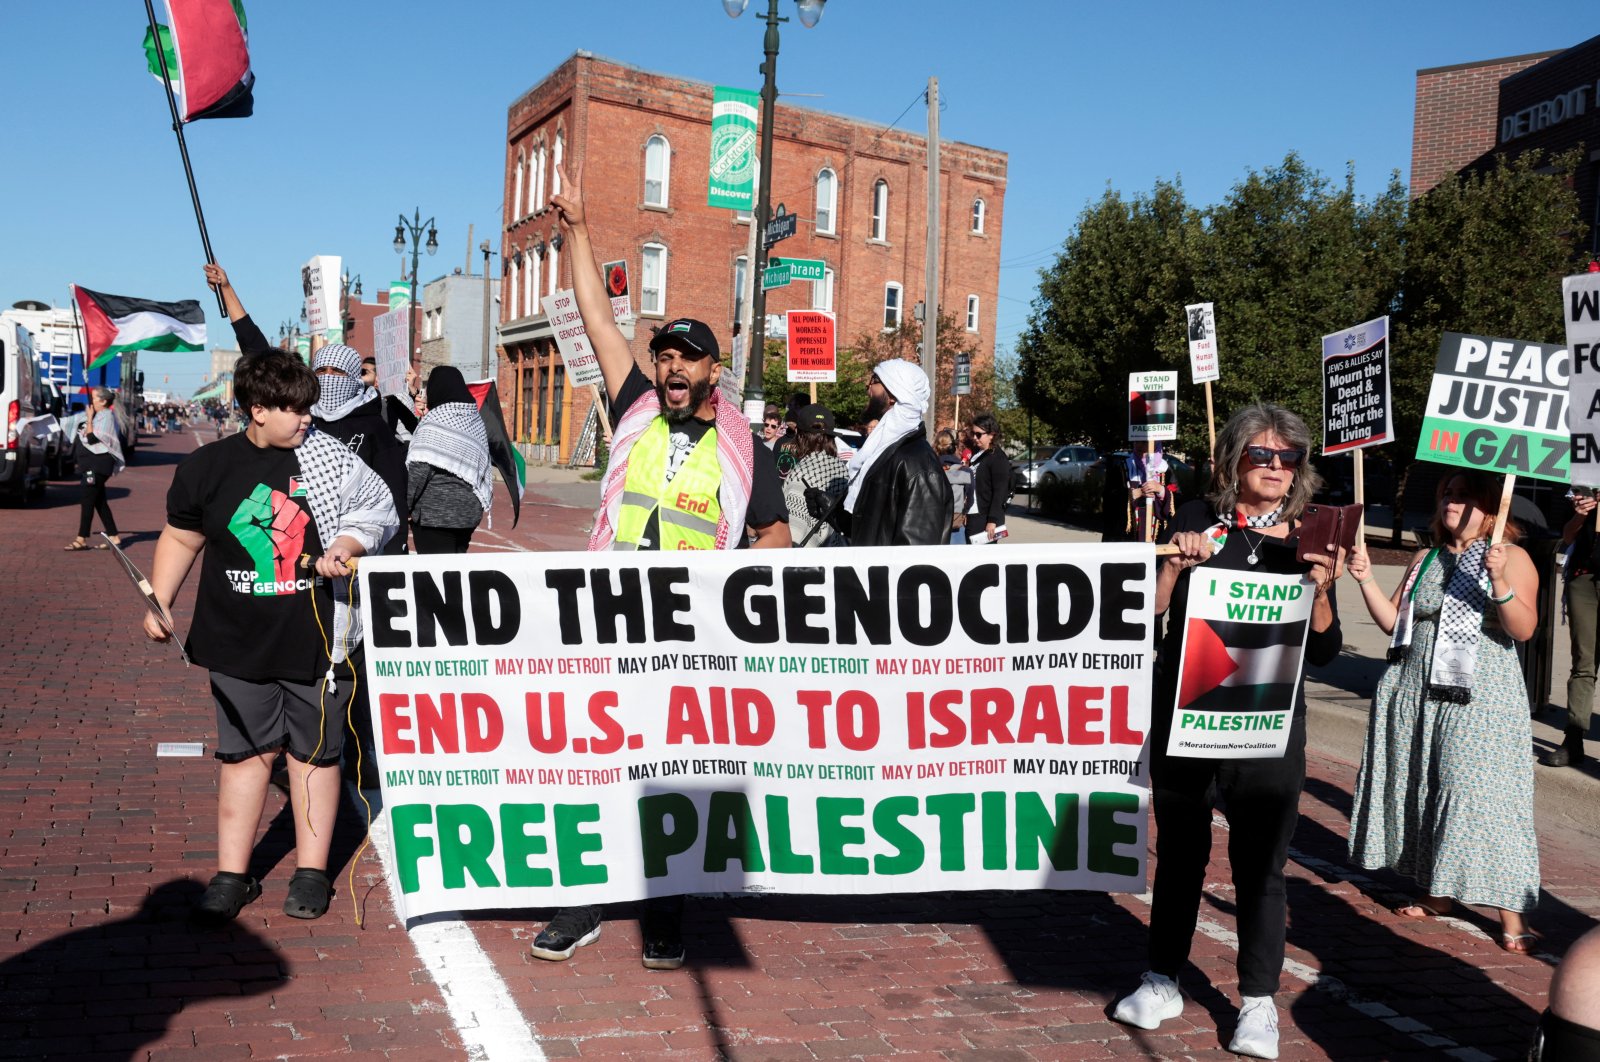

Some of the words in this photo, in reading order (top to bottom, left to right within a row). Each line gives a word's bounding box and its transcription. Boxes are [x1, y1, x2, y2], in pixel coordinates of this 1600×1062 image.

[1501, 85, 1592, 143] DETROIT
[712, 132, 756, 176] Corktown
[710, 186, 752, 199] Discover
[767, 218, 790, 236] Michigan
[773, 260, 821, 277] hrane
[765, 270, 790, 285] Michigan
[554, 297, 570, 310] STOP
[550, 311, 581, 327] U.S./ISRA
[613, 307, 630, 317] OW!
[792, 315, 801, 323] ALL
[803, 315, 822, 323] POWER
[558, 325, 586, 340] GENOCID
[795, 326, 822, 334] WORKERS
[574, 341, 584, 352] IN
[795, 337, 827, 345] OPPRESSED
[1197, 342, 1211, 350] Fund
[799, 347, 824, 355] PEOPLES
[1195, 353, 1213, 361] Human
[568, 355, 597, 369] PALESTIN
[811, 358, 833, 366] WORLD!
[1196, 364, 1215, 373] Needs!
[1327, 361, 1344, 374] JEWS
[1344, 359, 1350, 369] &
[1350, 353, 1371, 367] ALLIES
[1371, 349, 1384, 361] SAY
[1454, 337, 1570, 387] PEAC
[1143, 375, 1170, 383] STAND
[1329, 370, 1363, 389] Mourn
[1363, 363, 1382, 377] the
[1143, 383, 1164, 391] WITH
[1338, 381, 1363, 401] Dead
[1365, 378, 1374, 392] &
[1331, 399, 1358, 417] Fight
[1359, 394, 1380, 409] Like
[1438, 379, 1570, 431] JUSTI
[1328, 415, 1349, 432] Hell
[1350, 411, 1366, 423] for
[1366, 406, 1384, 421] the
[1132, 424, 1174, 432] PALESTINE
[1340, 425, 1372, 443] Living
[1429, 429, 1460, 453] IN
[1462, 428, 1570, 479] GAZ
[675, 492, 710, 514] End
[225, 569, 259, 582] STOP
[229, 580, 251, 594] THE
[1209, 579, 1217, 596] I
[1228, 581, 1303, 601] STAND
[368, 570, 521, 648] END
[545, 566, 696, 645] THE
[723, 562, 1147, 647] GENOCIDE
[1226, 602, 1283, 622] WITH
[376, 660, 401, 677] MAY
[406, 660, 430, 677] DAY
[435, 659, 489, 677] DETROIT
[495, 658, 523, 675] MAY
[528, 658, 553, 675] DAY
[558, 657, 612, 674] DETROIT
[618, 657, 647, 674] MAY
[652, 653, 678, 672] DAY
[683, 654, 738, 672] DETROIT
[745, 656, 775, 672] MAY
[780, 656, 807, 673] DAY
[811, 657, 869, 674] DETROIT
[876, 658, 907, 675] MAY
[912, 658, 941, 675] DAY
[946, 656, 1006, 675] DETROIT
[1012, 654, 1045, 671] MAY
[1049, 652, 1078, 669] DAY
[1082, 652, 1145, 670] DETROIT
[379, 692, 504, 755] END
[525, 690, 644, 755] U.S.
[666, 685, 776, 747] AID
[797, 689, 881, 752] TO
[906, 684, 1144, 750] ISRAEL
[1181, 713, 1286, 731] PALESTINE
[1178, 740, 1277, 750] @MoratoriumNowCoalition
[386, 769, 414, 788] MAY
[419, 770, 442, 786] DAY
[446, 768, 500, 786] DETROIT
[506, 768, 534, 785] MAY
[538, 768, 564, 785] DAY
[568, 767, 622, 786] DETROIT
[628, 762, 658, 781] MAY
[662, 759, 689, 777] DAY
[693, 759, 748, 777] DETROIT
[753, 761, 782, 779] MAY
[787, 763, 814, 779] DAY
[818, 764, 876, 781] DETROIT
[881, 764, 912, 780] MAY
[917, 762, 945, 779] DAY
[949, 758, 1007, 777] DETROIT
[1013, 758, 1046, 775] MAY
[1050, 760, 1079, 776] DAY
[1082, 759, 1142, 777] DETROIT
[390, 802, 609, 895] FREE
[637, 791, 1141, 878] PALESTINE
